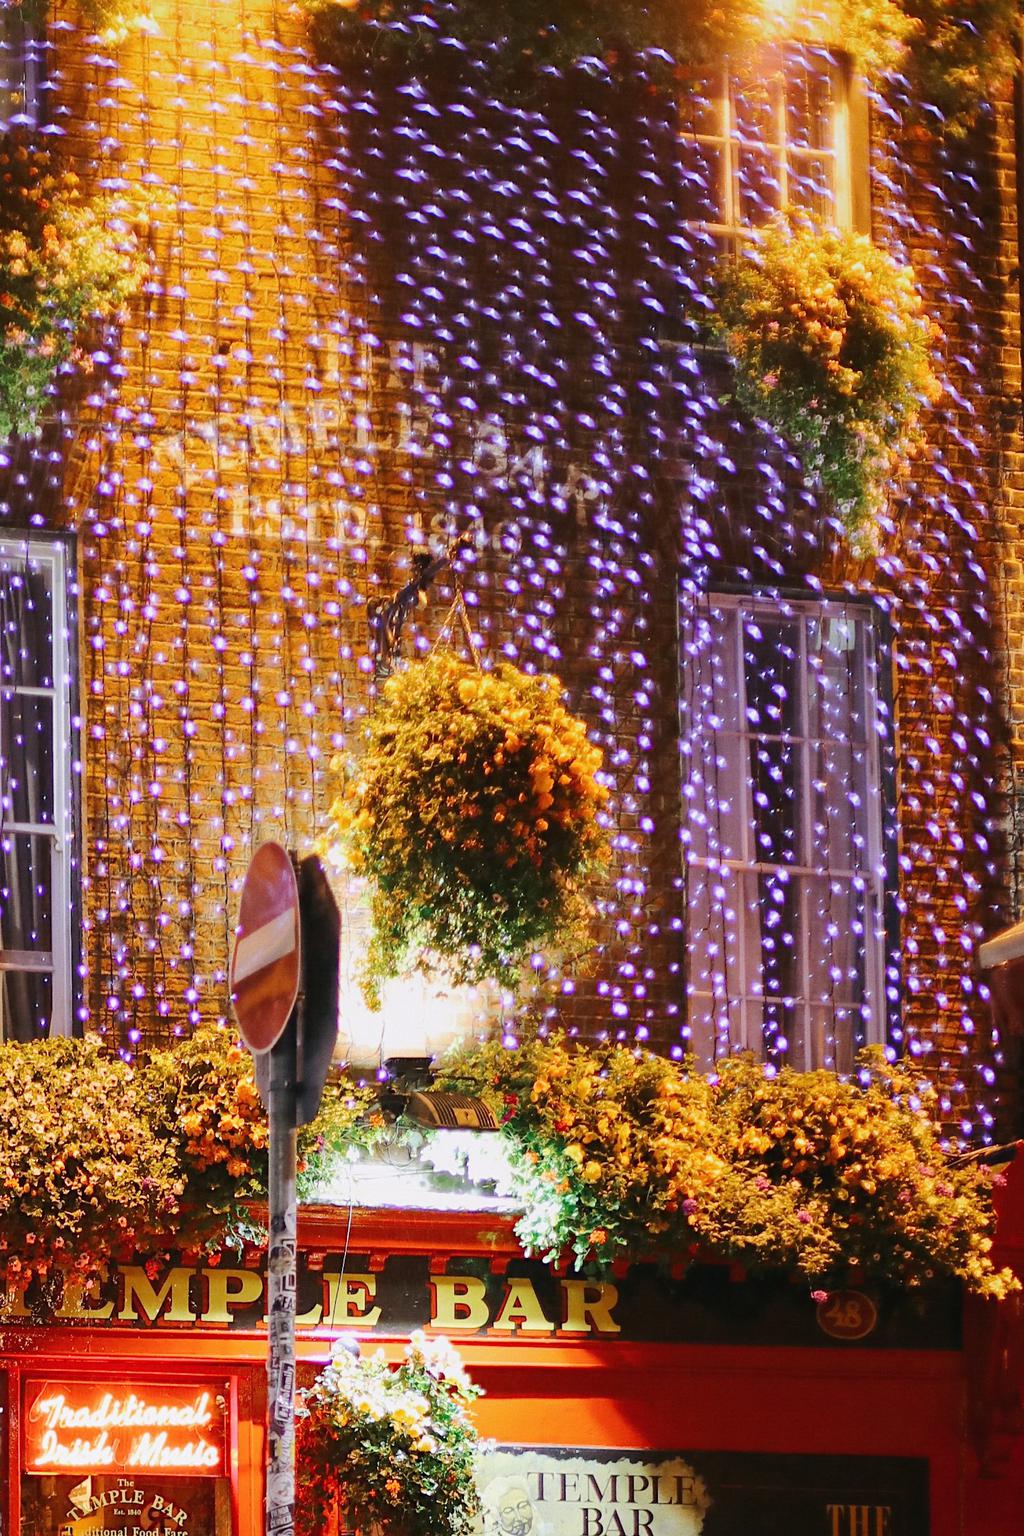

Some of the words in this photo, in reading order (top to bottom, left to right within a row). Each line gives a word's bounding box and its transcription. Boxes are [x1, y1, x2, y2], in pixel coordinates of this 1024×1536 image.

[430, 1274, 622, 1334] BAR
[825, 1299, 862, 1329] 48
[38, 1391, 213, 1429] Traditional
[34, 1429, 116, 1466] Irish
[128, 1430, 221, 1468] Music
[117, 1478, 135, 1488] The
[526, 1470, 698, 1506] TEMPLE
[66, 1489, 145, 1522] TEMPLE
[152, 1494, 188, 1527] BAR
[127, 1508, 142, 1516] 1840
